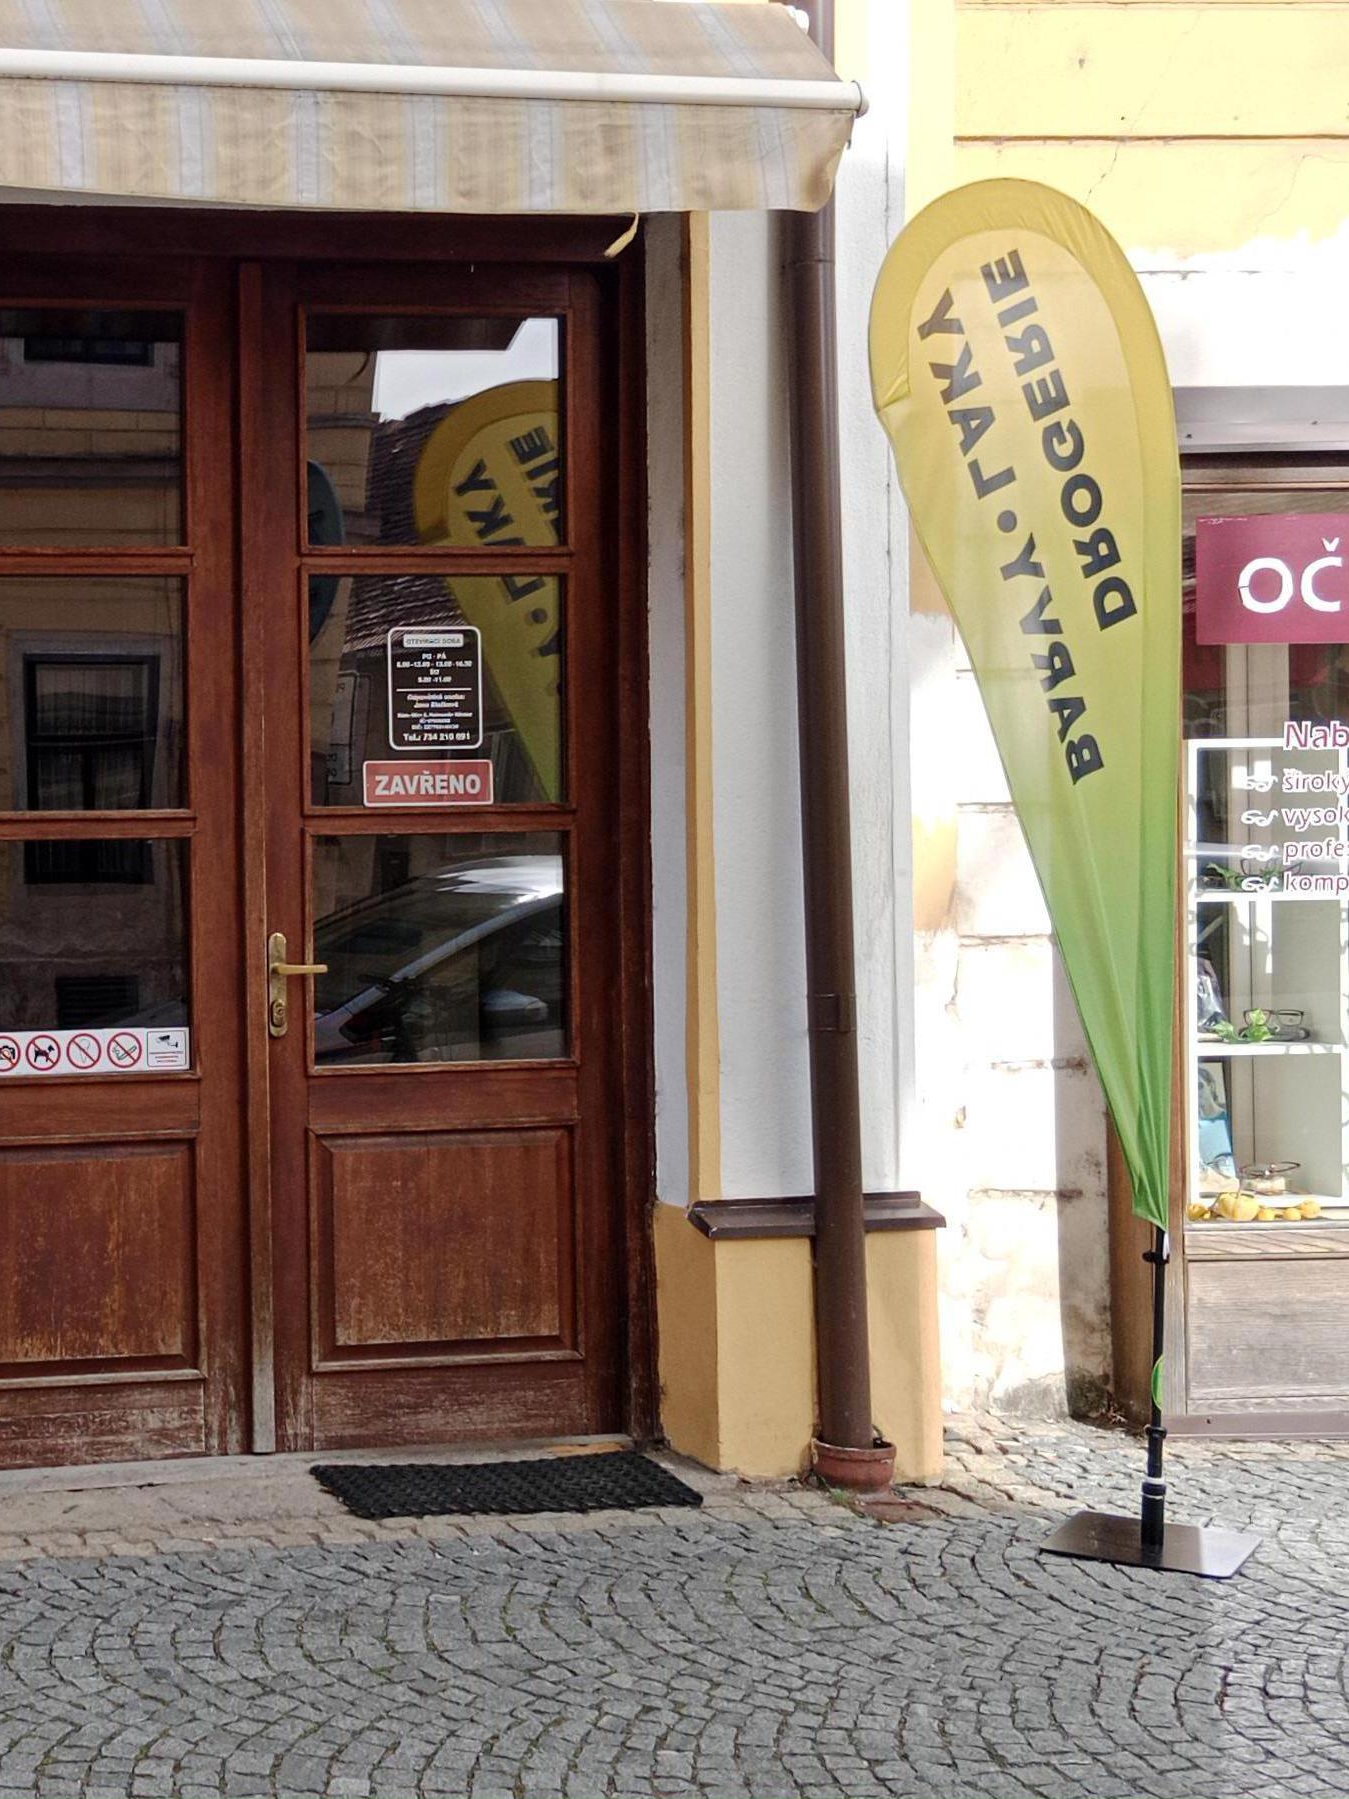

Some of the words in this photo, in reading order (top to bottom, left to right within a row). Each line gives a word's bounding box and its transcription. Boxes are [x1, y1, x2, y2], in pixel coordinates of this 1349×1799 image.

[1238, 537, 1343, 614] OČ
[375, 770, 482, 796] ZAVŘENO
[1284, 839, 1349, 862] profe
